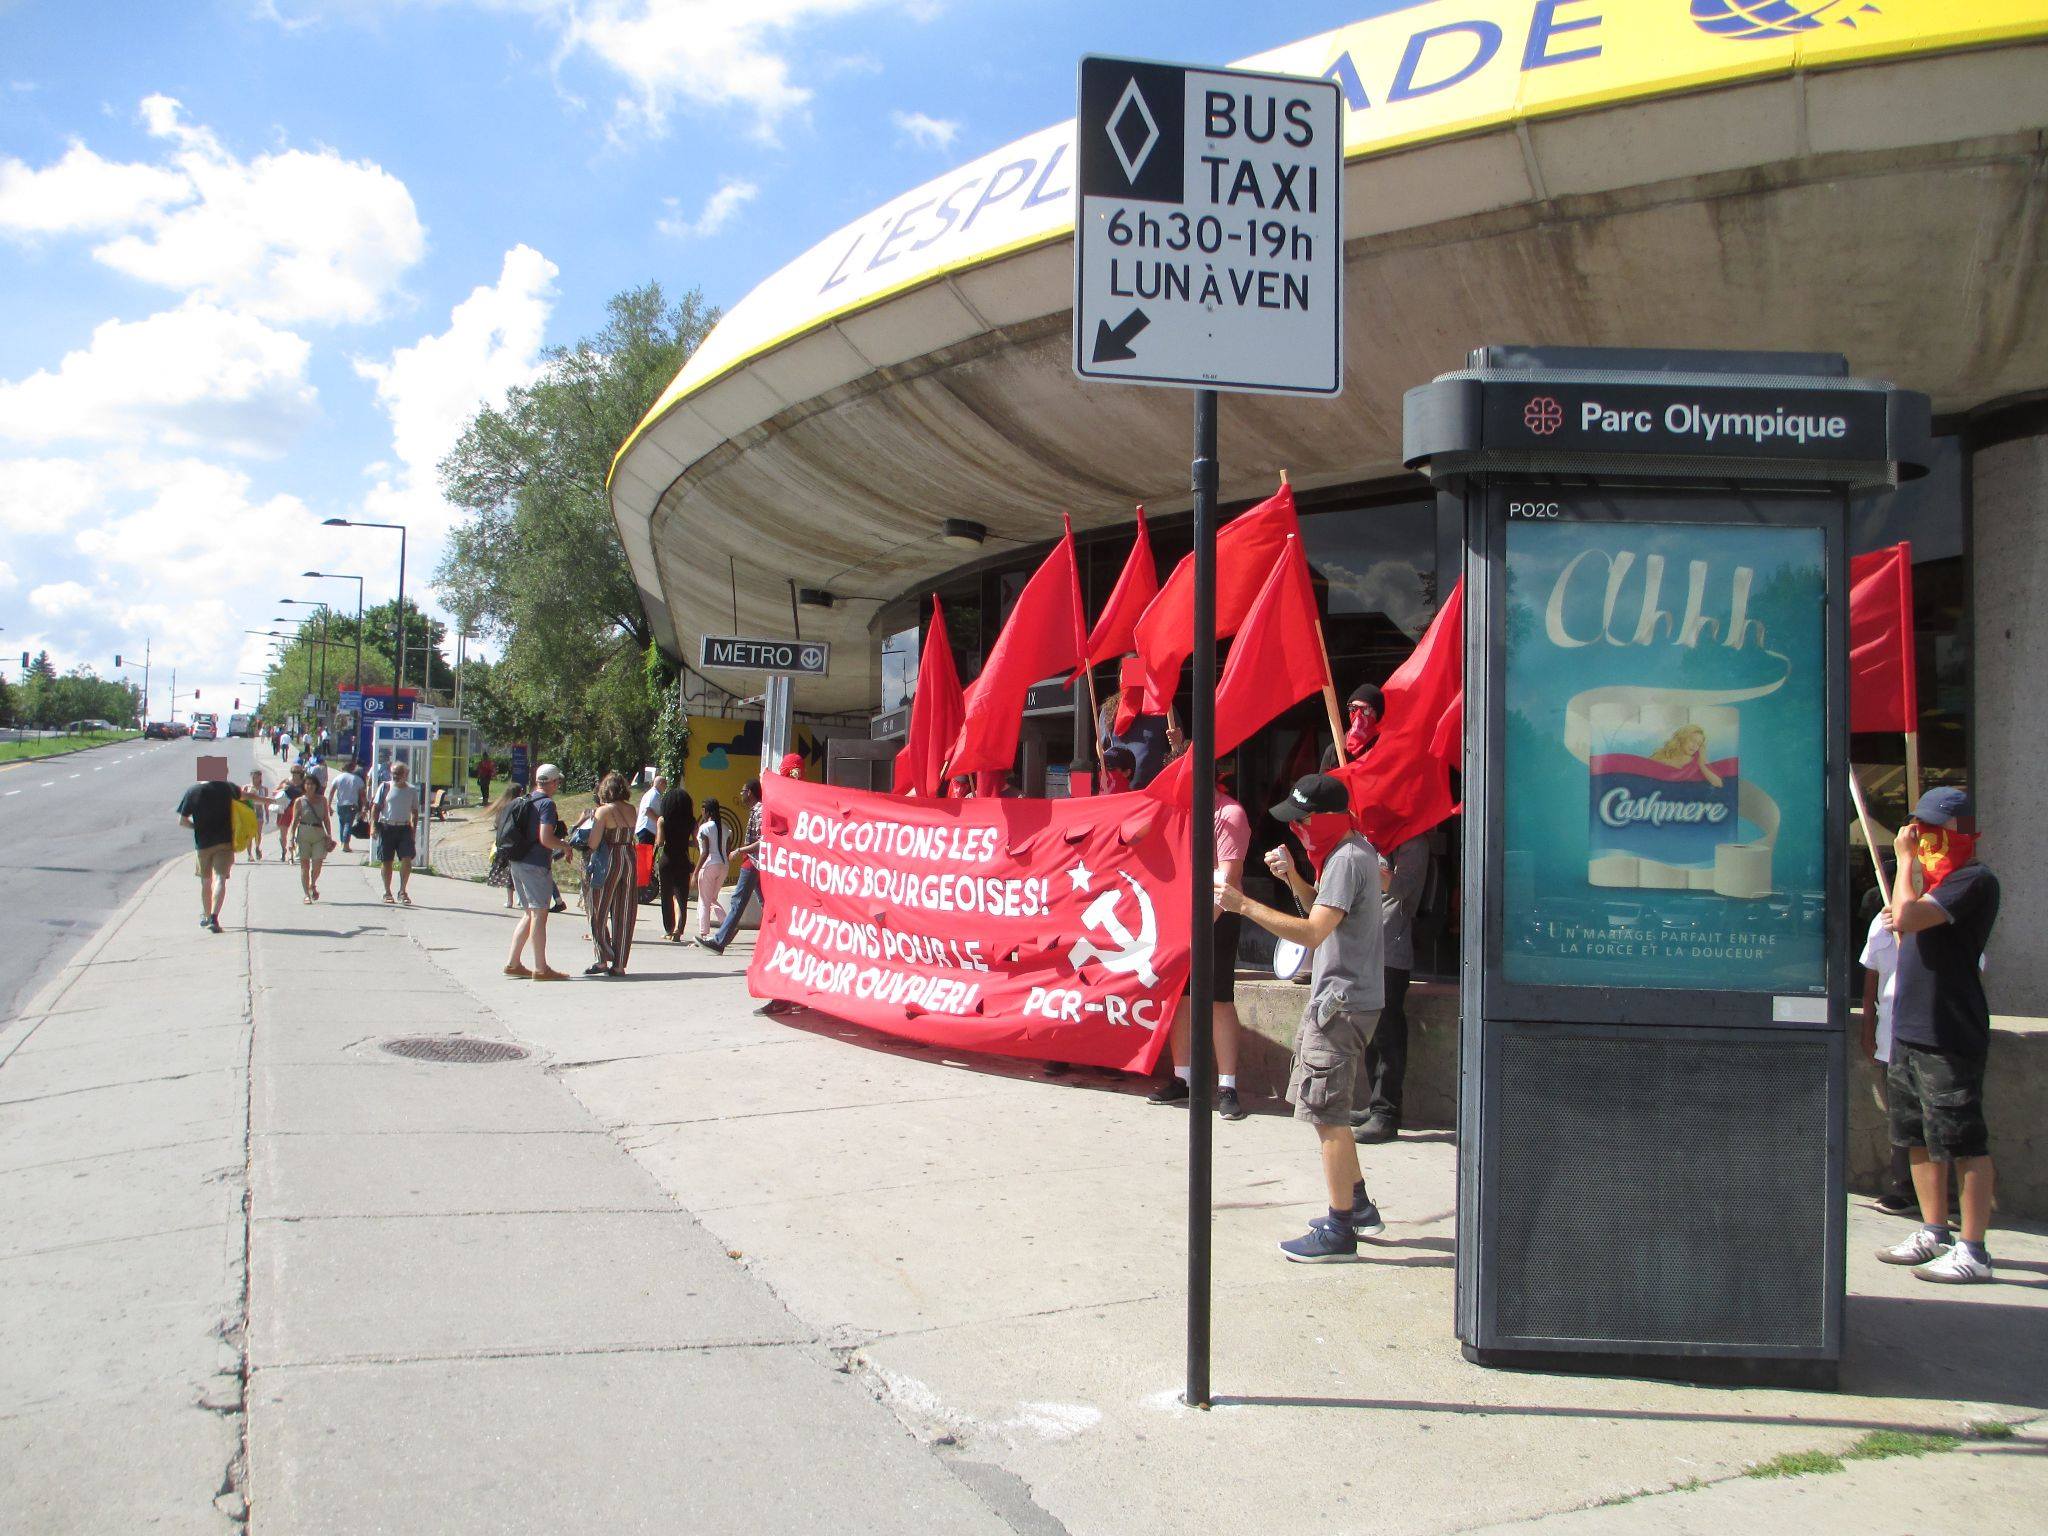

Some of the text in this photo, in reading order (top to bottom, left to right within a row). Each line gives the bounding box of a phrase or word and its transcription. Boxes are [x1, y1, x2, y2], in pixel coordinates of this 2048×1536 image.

[1205, 90, 1313, 148] BUS
[1201, 156, 1317, 214] TAXI
[1108, 208, 1312, 261] 6h30-19h
[1111, 258, 1309, 311] LUN À VEN
[1581, 402, 1847, 443] Parc Olympique
[393, 727, 414, 740] Bell
[1600, 787, 1729, 828] Cashmere
[793, 811, 998, 863] BOYCOTTONS LES
[860, 866, 1050, 917] BOURGEOISES!
[788, 905, 989, 972] LUTTONS POUR LE
[1561, 943, 1763, 960] LA FORCE ET LA DOUCEUR
[1661, 931, 1723, 945] PARFAIT
[1730, 933, 1776, 945] ENTRE
[765, 941, 980, 1014] POUVOIR OUVRIER!
